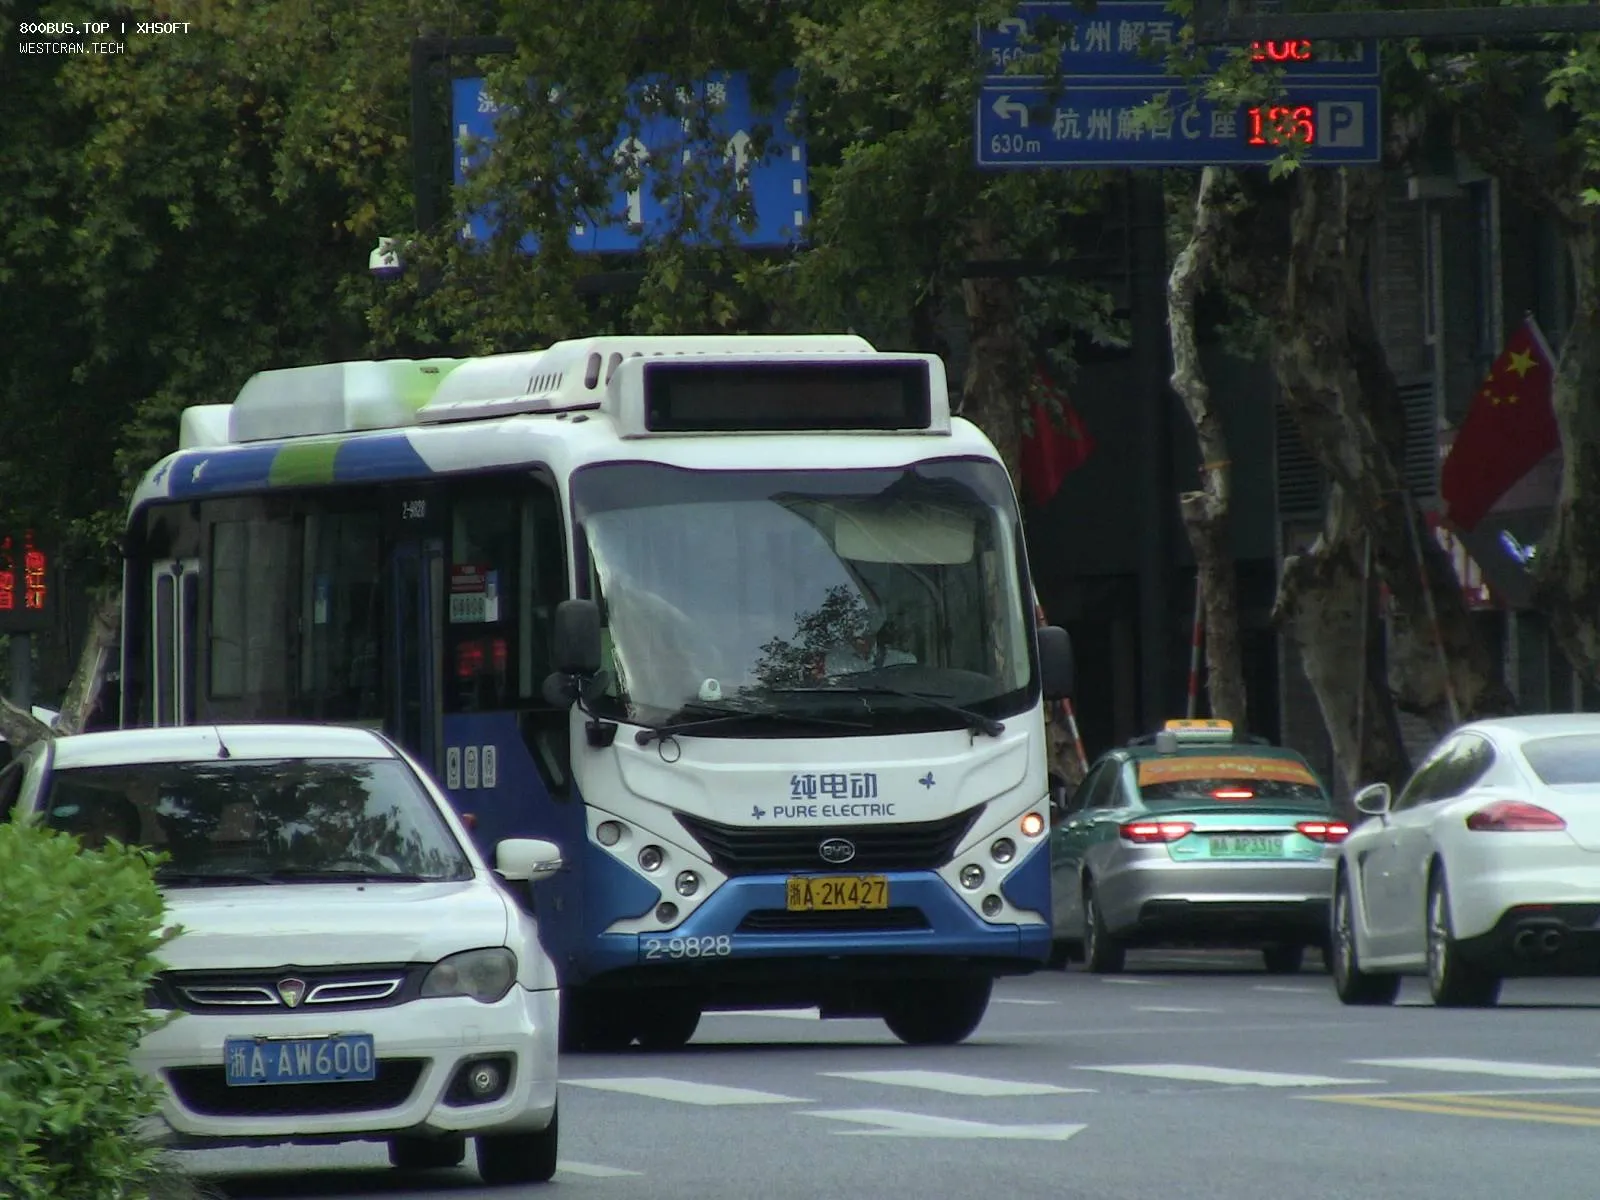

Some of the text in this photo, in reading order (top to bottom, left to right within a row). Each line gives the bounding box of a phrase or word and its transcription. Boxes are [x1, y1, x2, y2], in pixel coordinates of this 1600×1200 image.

[991, 134, 1041, 154] 630m
[790, 772, 878, 800] 纯电动
[773, 803, 896, 819] PURE ELECTRIC
[822, 845, 852, 856] BYD
[645, 934, 732, 960] 2-9828
